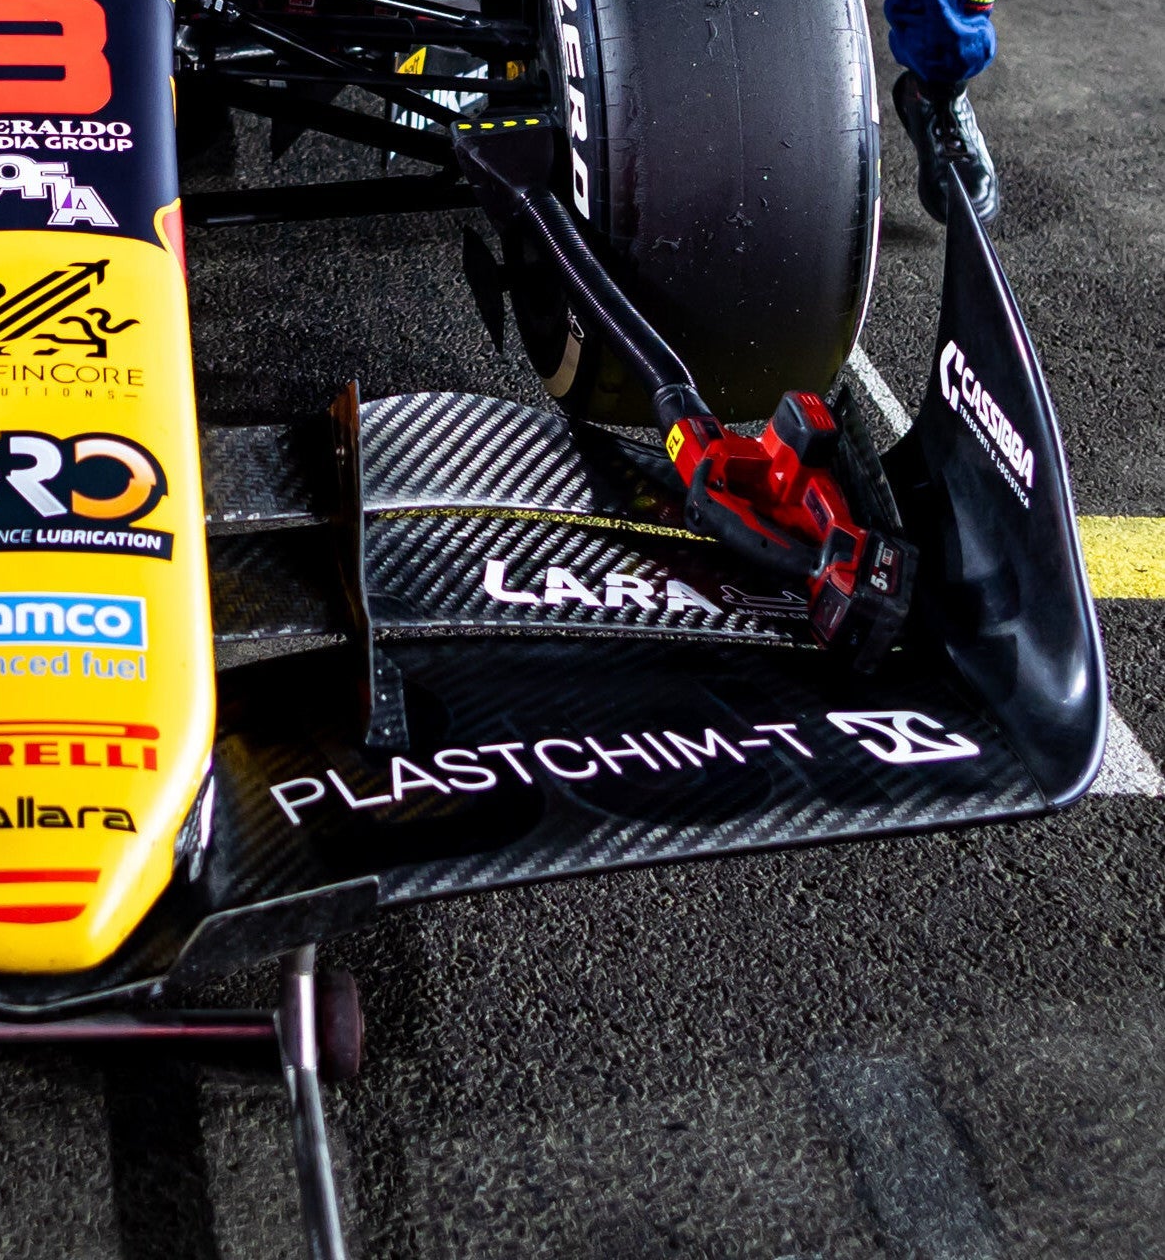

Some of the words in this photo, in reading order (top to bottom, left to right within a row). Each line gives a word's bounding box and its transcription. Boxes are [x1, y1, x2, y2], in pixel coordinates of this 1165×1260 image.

[53, 136, 134, 152] GROUP
[961, 367, 1035, 488] CASSIBBA
[959, 404, 990, 453] TRASPORTI
[996, 457, 1031, 509] LOGISTICA
[36, 528, 162, 551] LUBRICATION
[484, 559, 725, 616] LARA
[82, 651, 148, 681] fuel
[269, 722, 815, 826] PLASTCHIM-T
